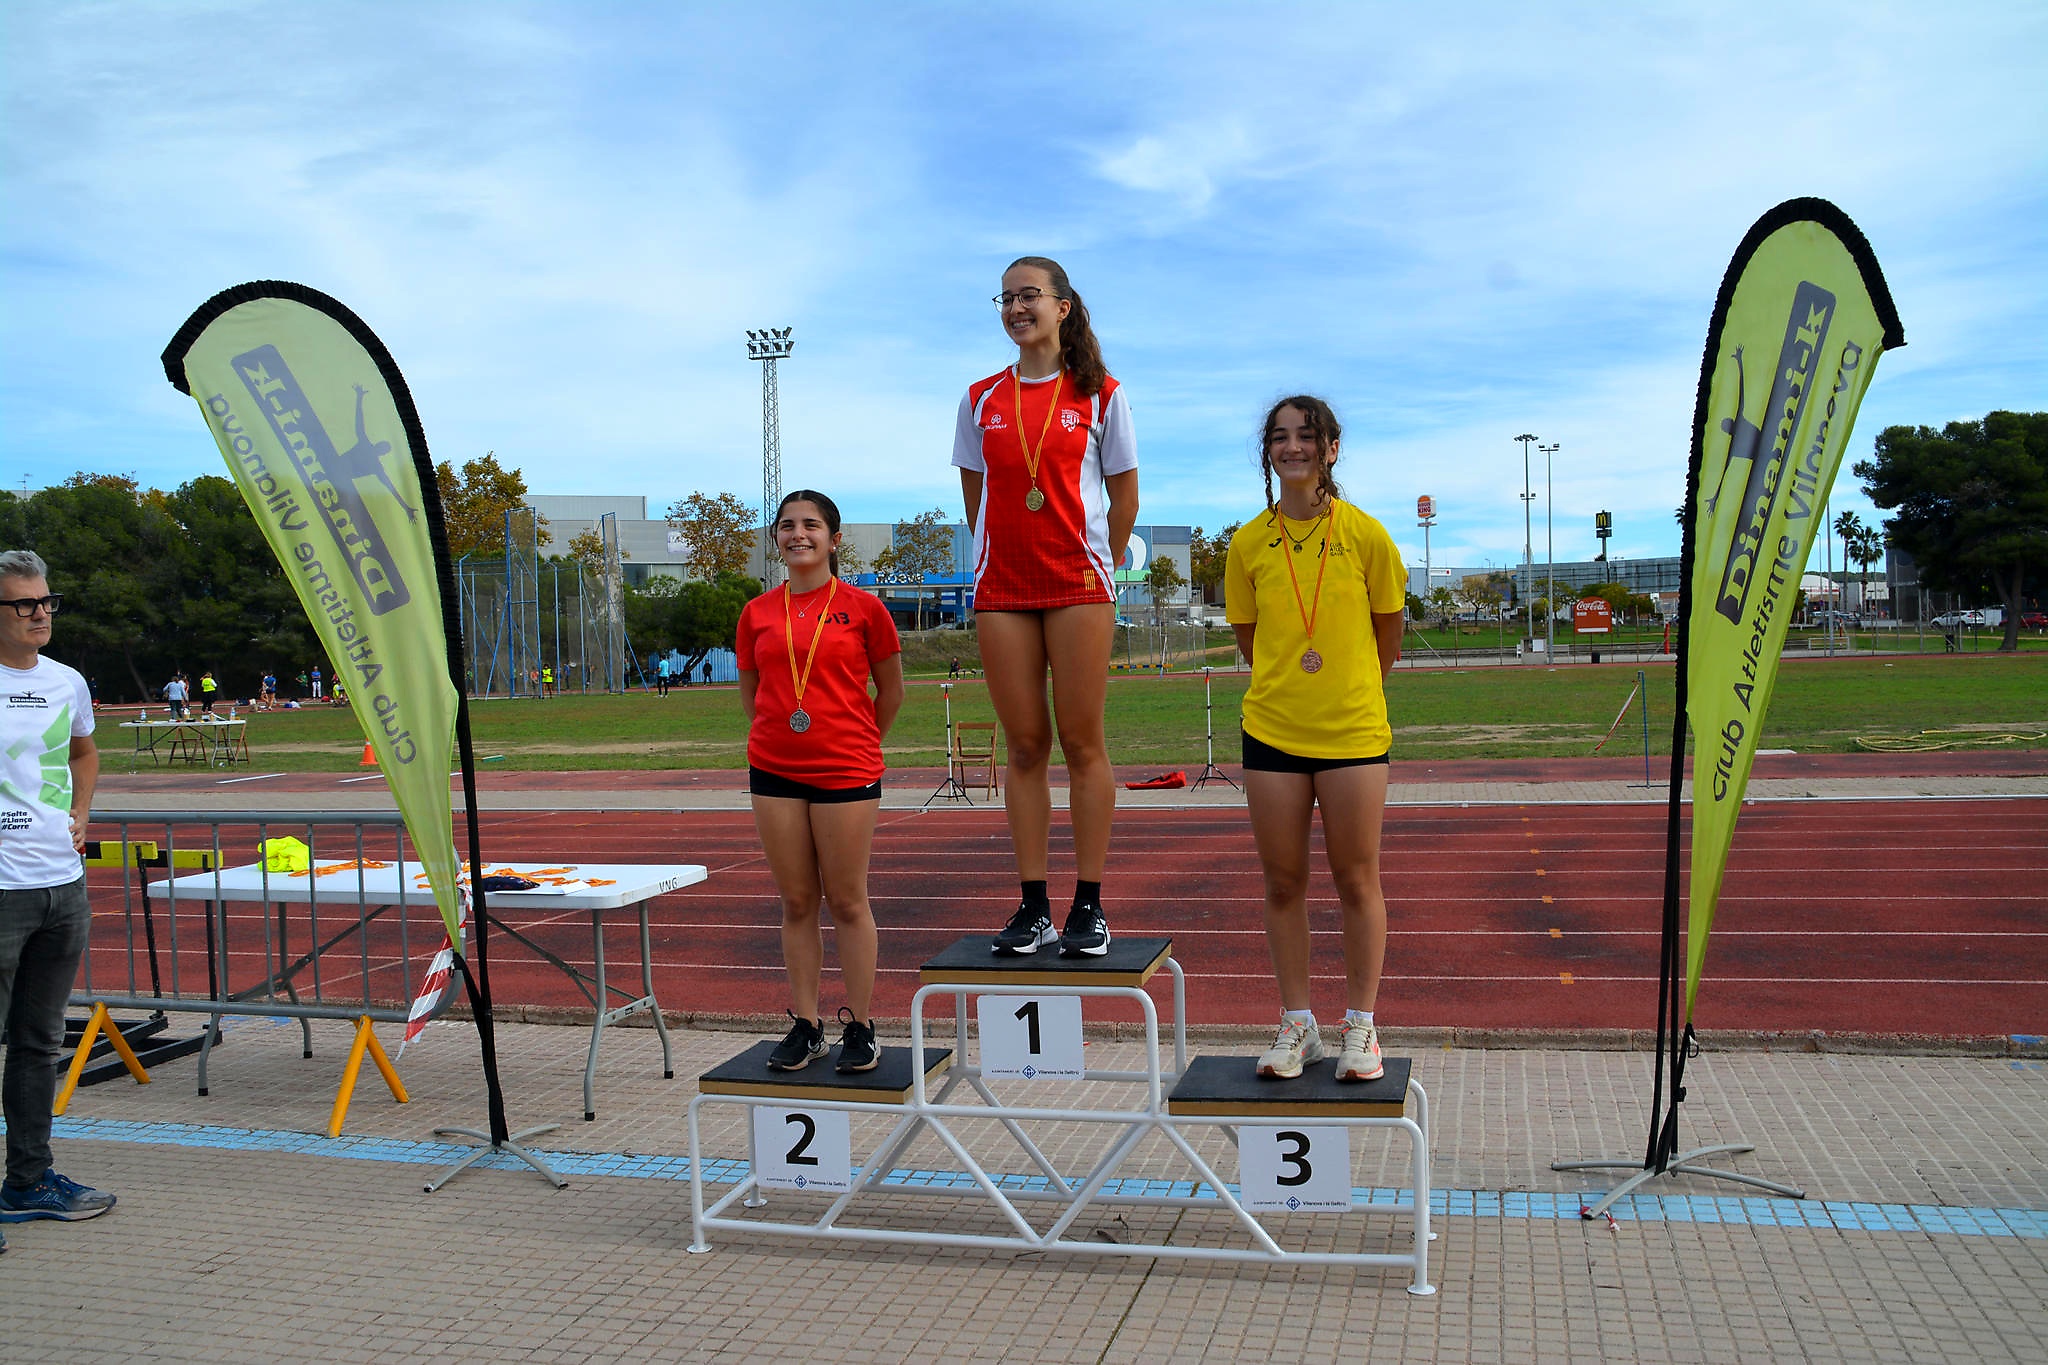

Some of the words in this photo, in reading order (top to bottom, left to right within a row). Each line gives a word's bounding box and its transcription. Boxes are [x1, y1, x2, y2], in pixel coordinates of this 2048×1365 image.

[1713, 719, 1745, 802] Club
[1733, 535, 1798, 713] Atletisme
[1784, 340, 1863, 520] Vilanova
[1577, 600, 1606, 611] Coca-Cola
[659, 876, 678, 893] VNG
[1014, 1001, 1041, 1054] 1
[785, 1113, 818, 1166] 2
[1276, 1131, 1312, 1186] 3
